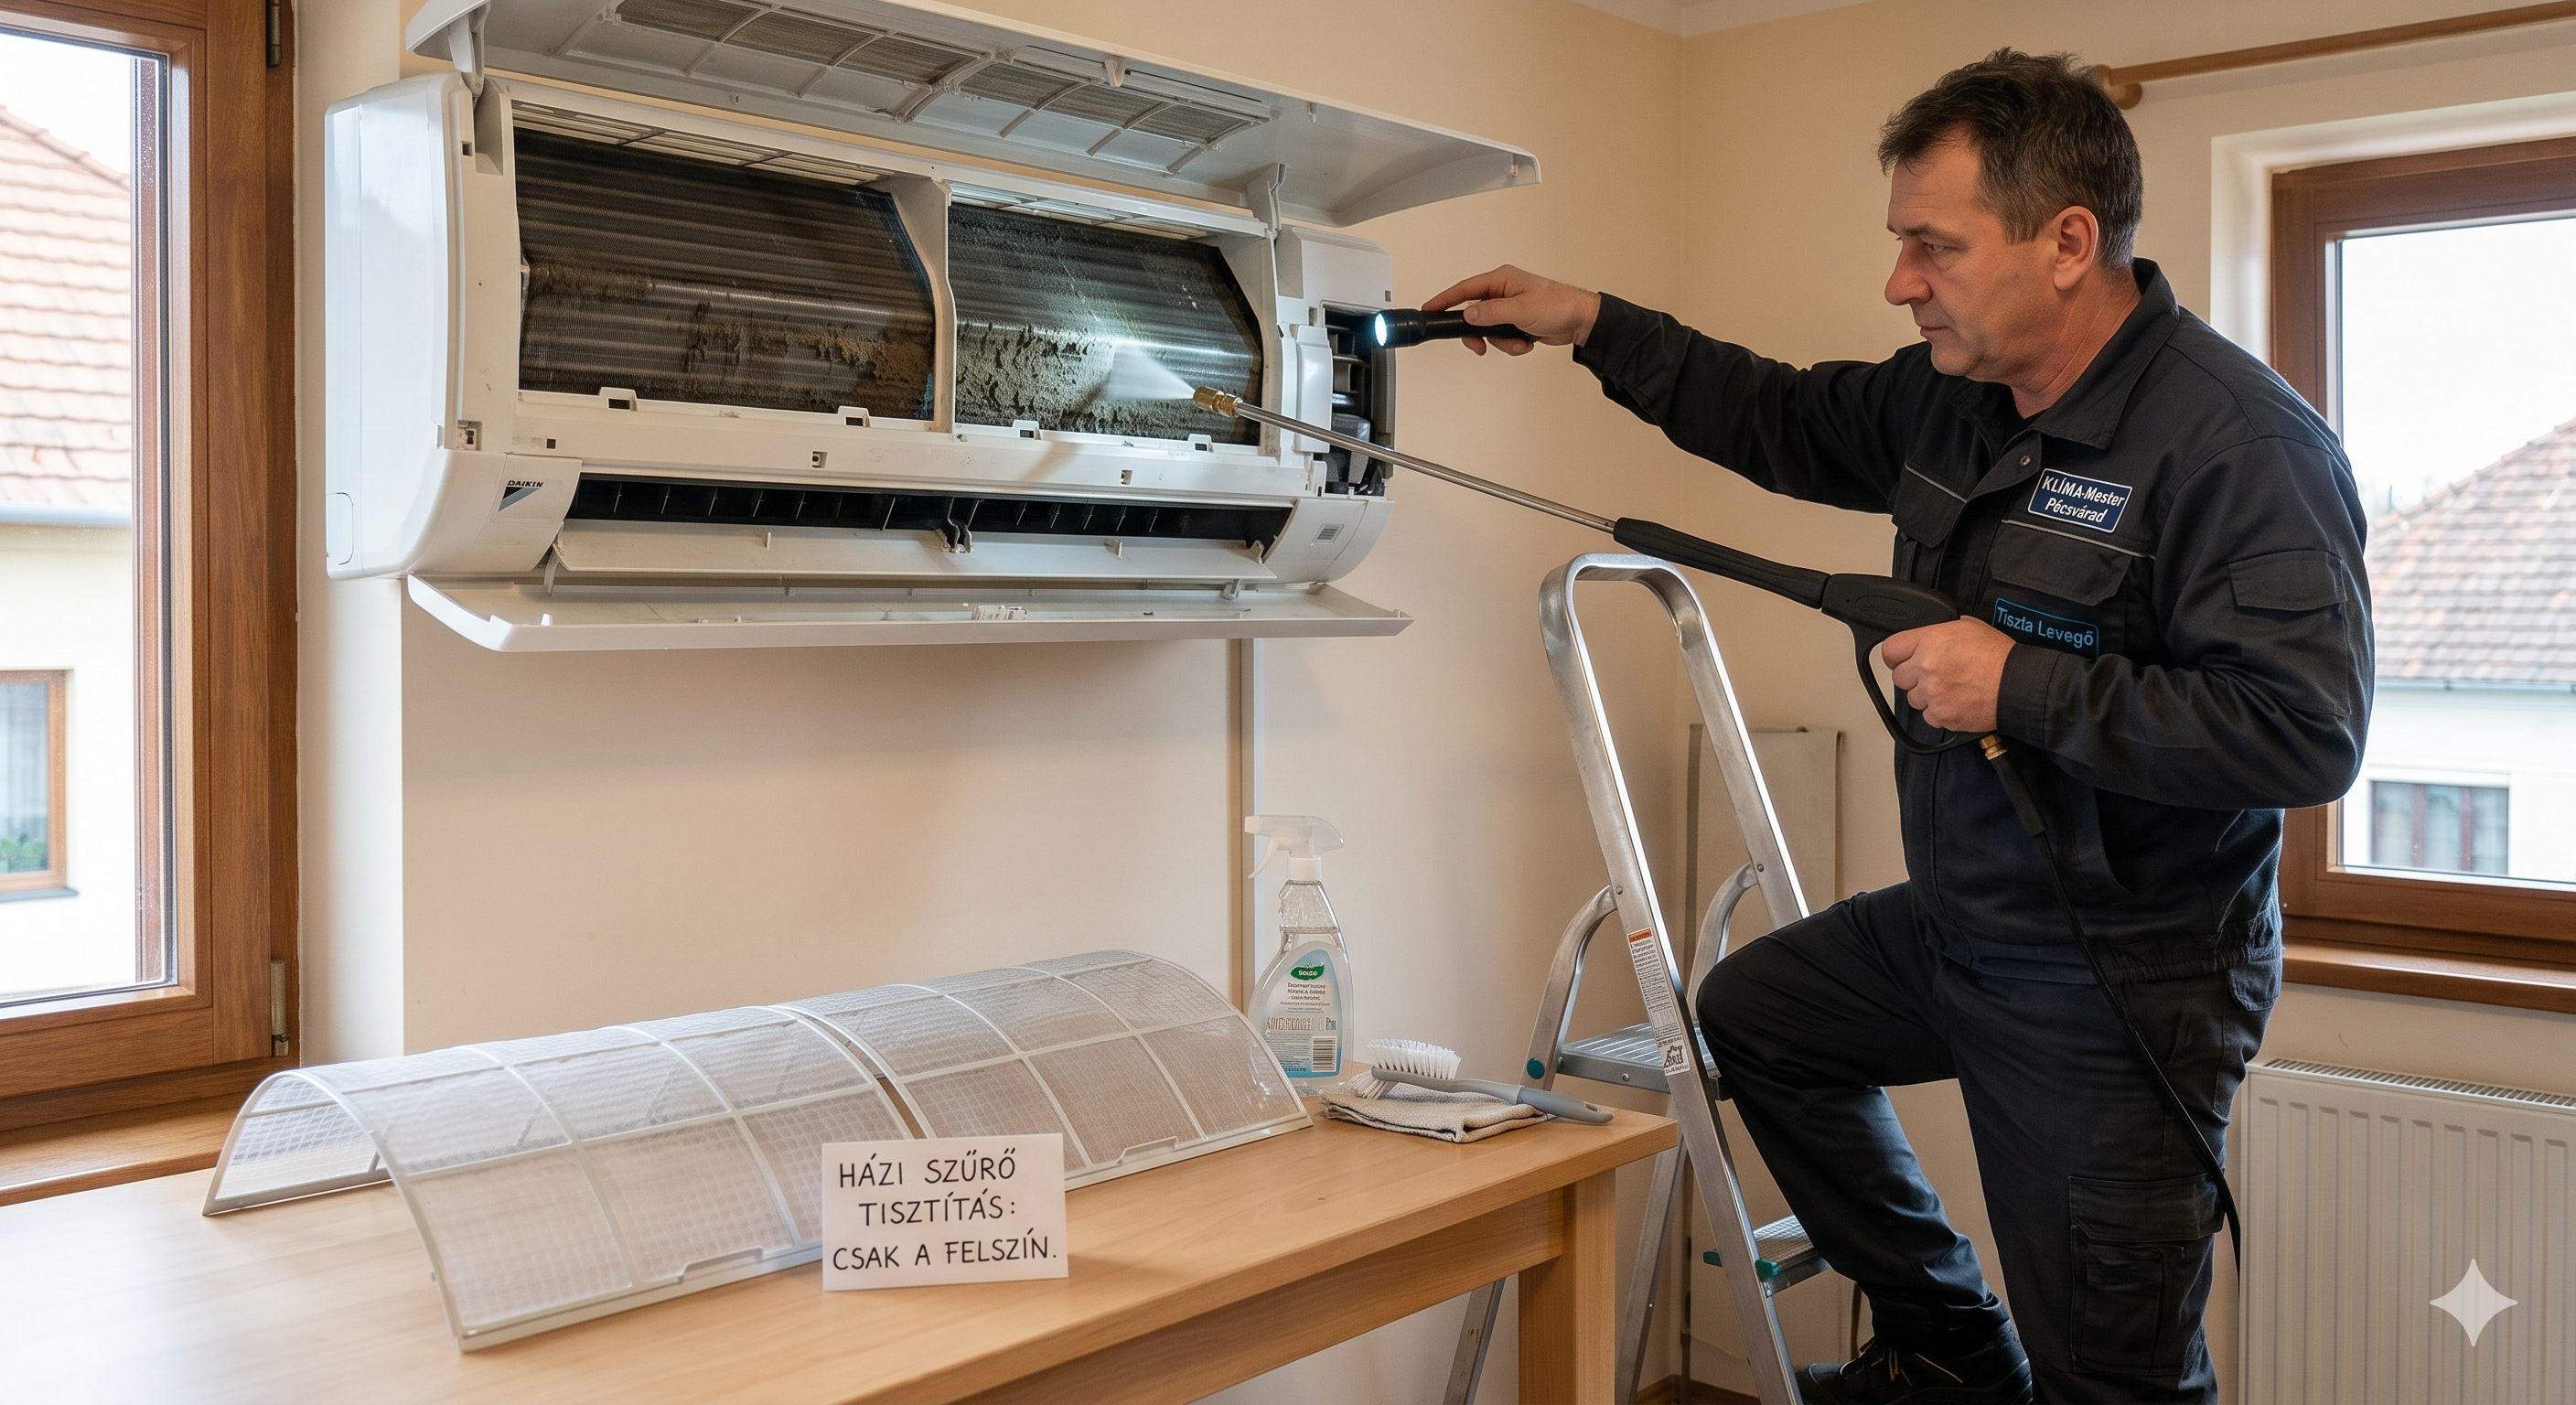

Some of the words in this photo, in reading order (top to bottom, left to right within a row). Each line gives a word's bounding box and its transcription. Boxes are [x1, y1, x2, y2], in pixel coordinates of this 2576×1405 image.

[2042, 476, 2125, 507] KLÍMA-Mester
[2045, 498, 2109, 522] Pécsvárad
[1997, 606, 2034, 633] Tiszta
[840, 1153, 903, 1188] HÁZI
[924, 1147, 1015, 1184] SZŰRŐ
[858, 1187, 1015, 1227] TISZTÍTÁS:
[832, 1245, 900, 1271] CSAK
[915, 1243, 931, 1266] A
[944, 1227, 1057, 1264] FELSZÍN.
